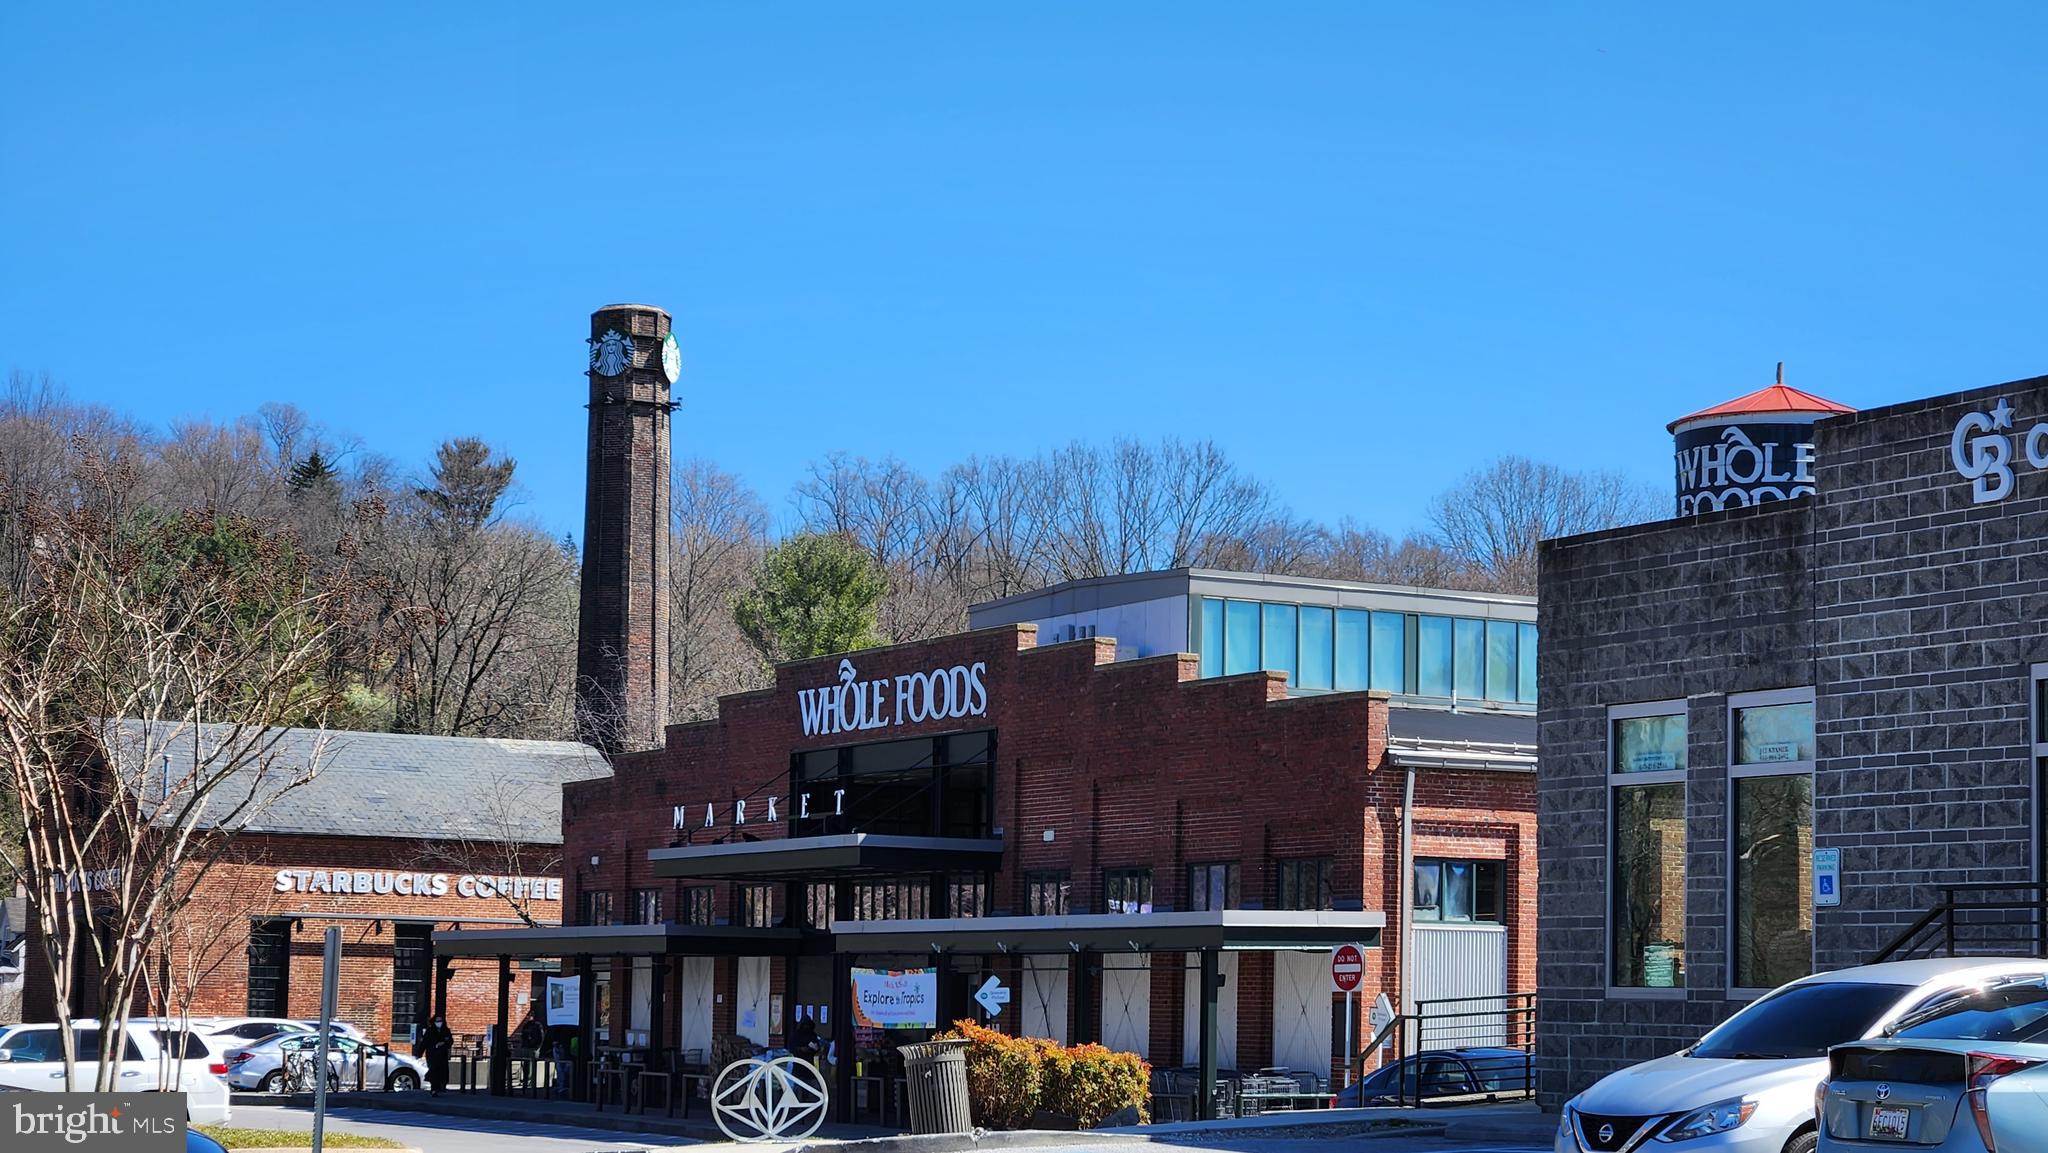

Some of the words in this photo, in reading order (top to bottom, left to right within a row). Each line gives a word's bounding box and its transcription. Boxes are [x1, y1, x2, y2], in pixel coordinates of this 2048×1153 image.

[1677, 426, 1815, 491] WHOLE
[798, 658, 889, 737] WHOLE
[894, 661, 987, 726] FOODS
[672, 789, 845, 830] MARKET
[275, 870, 448, 896] STARBUCKS
[458, 875, 561, 900] COFFEE
[1339, 974, 1356, 982] ENTER
[863, 989, 895, 1007] Explore
[901, 991, 925, 1008] Tropics
